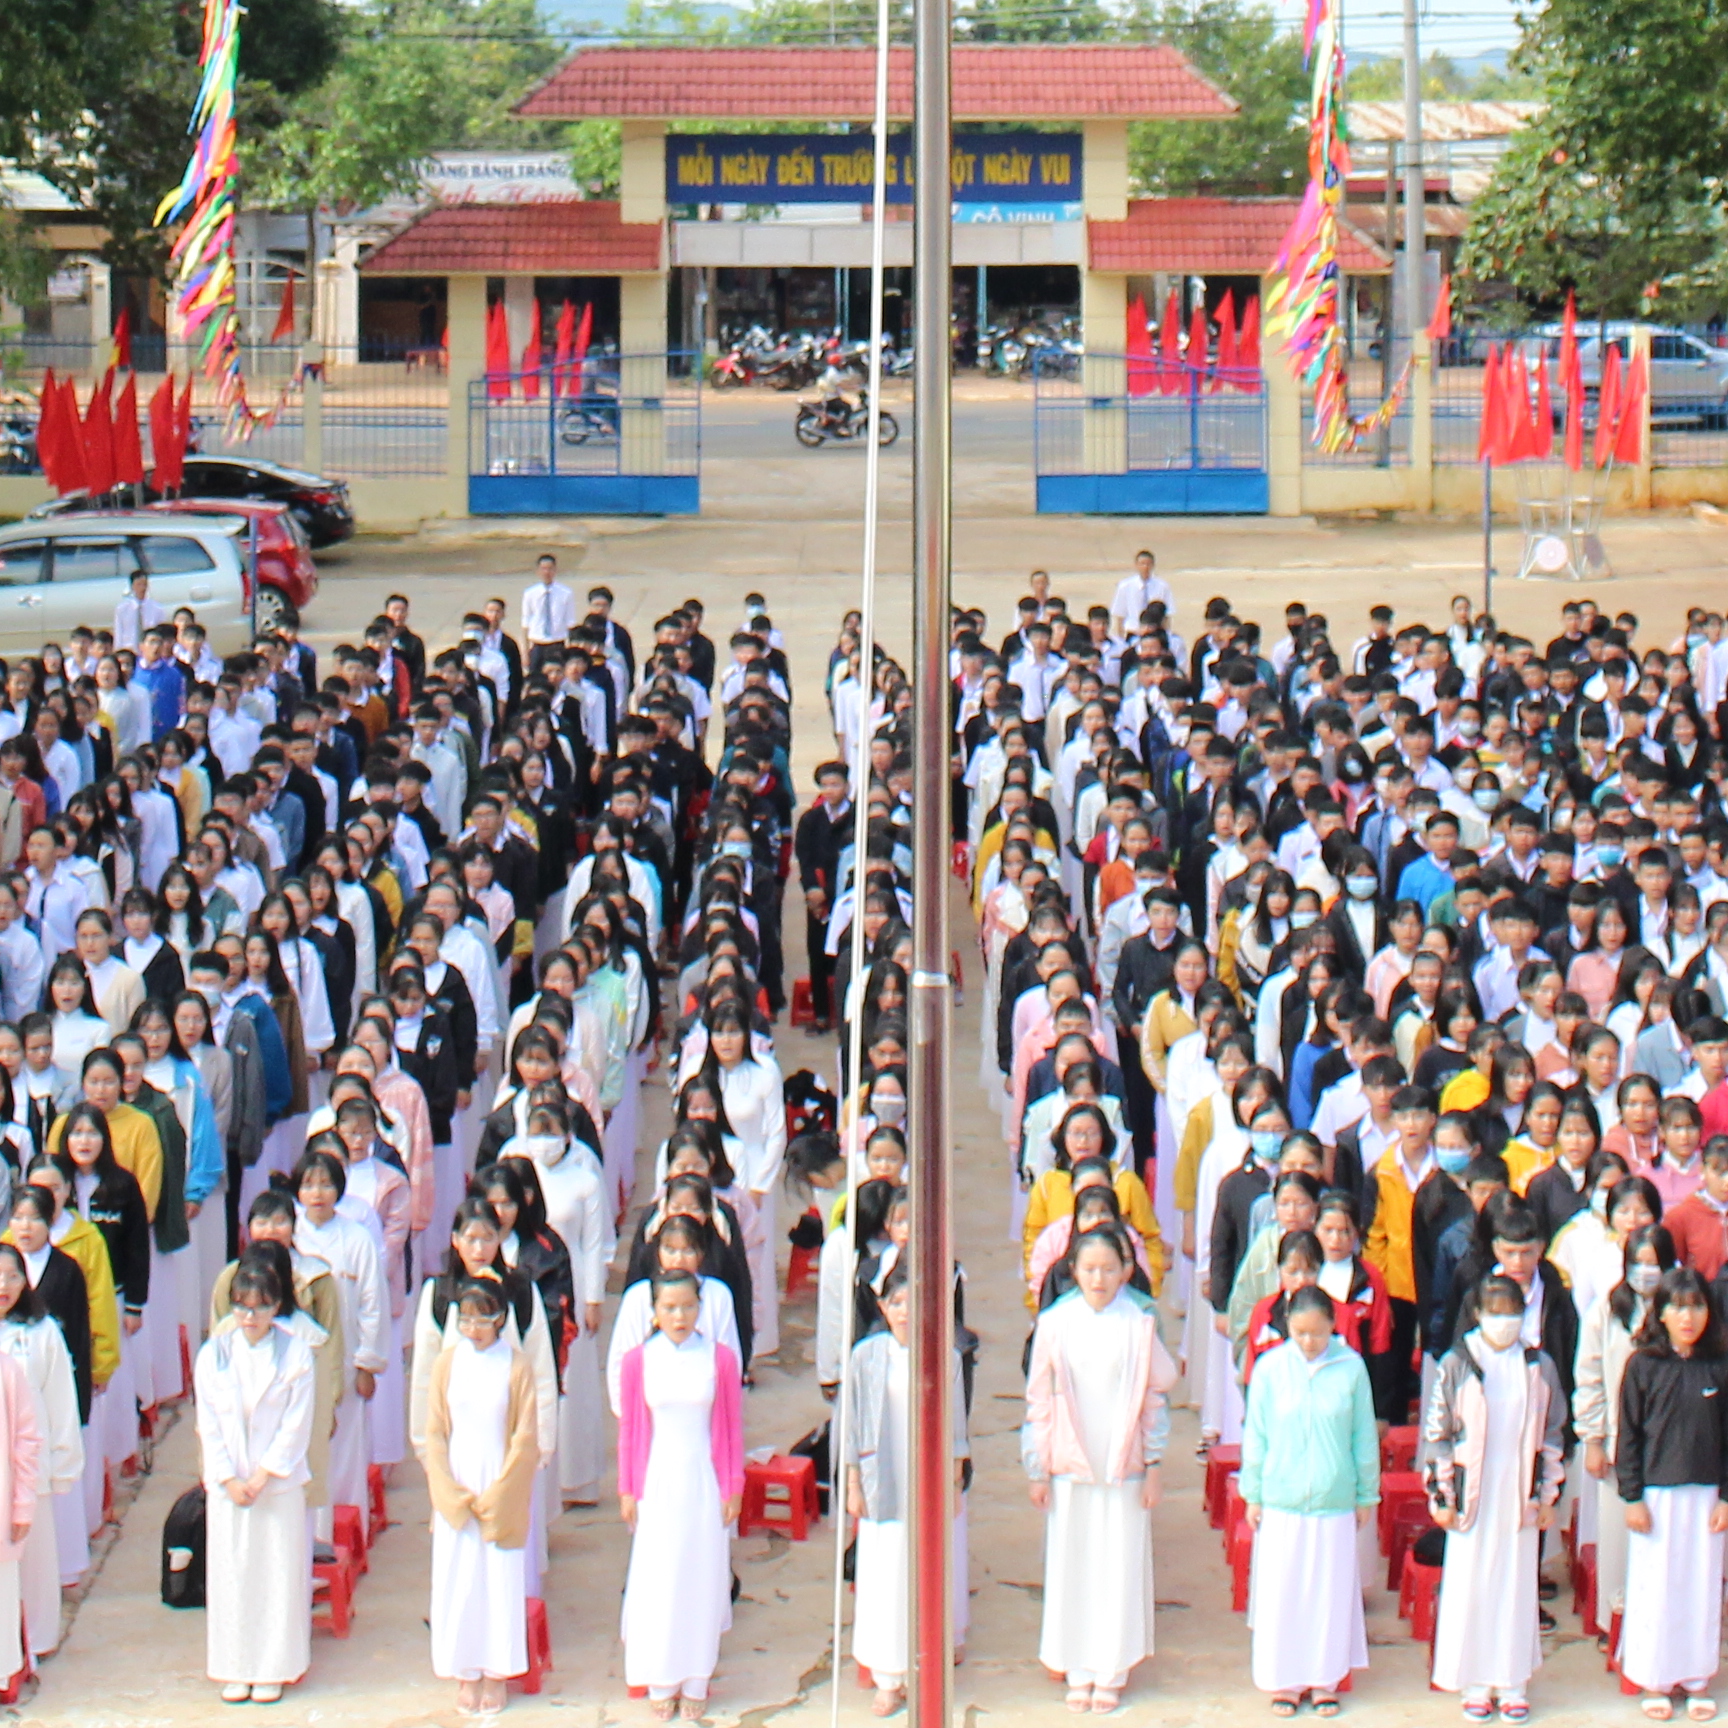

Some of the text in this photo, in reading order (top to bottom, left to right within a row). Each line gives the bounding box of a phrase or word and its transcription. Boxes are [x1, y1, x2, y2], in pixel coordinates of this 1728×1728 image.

[721, 148, 770, 186] NGÀY
[776, 145, 815, 186] ĐẾN
[821, 147, 898, 186] TRƯỜG
[950, 148, 976, 191] ỘT
[983, 148, 1032, 186] NGÀY
[1039, 154, 1070, 185] VUI
